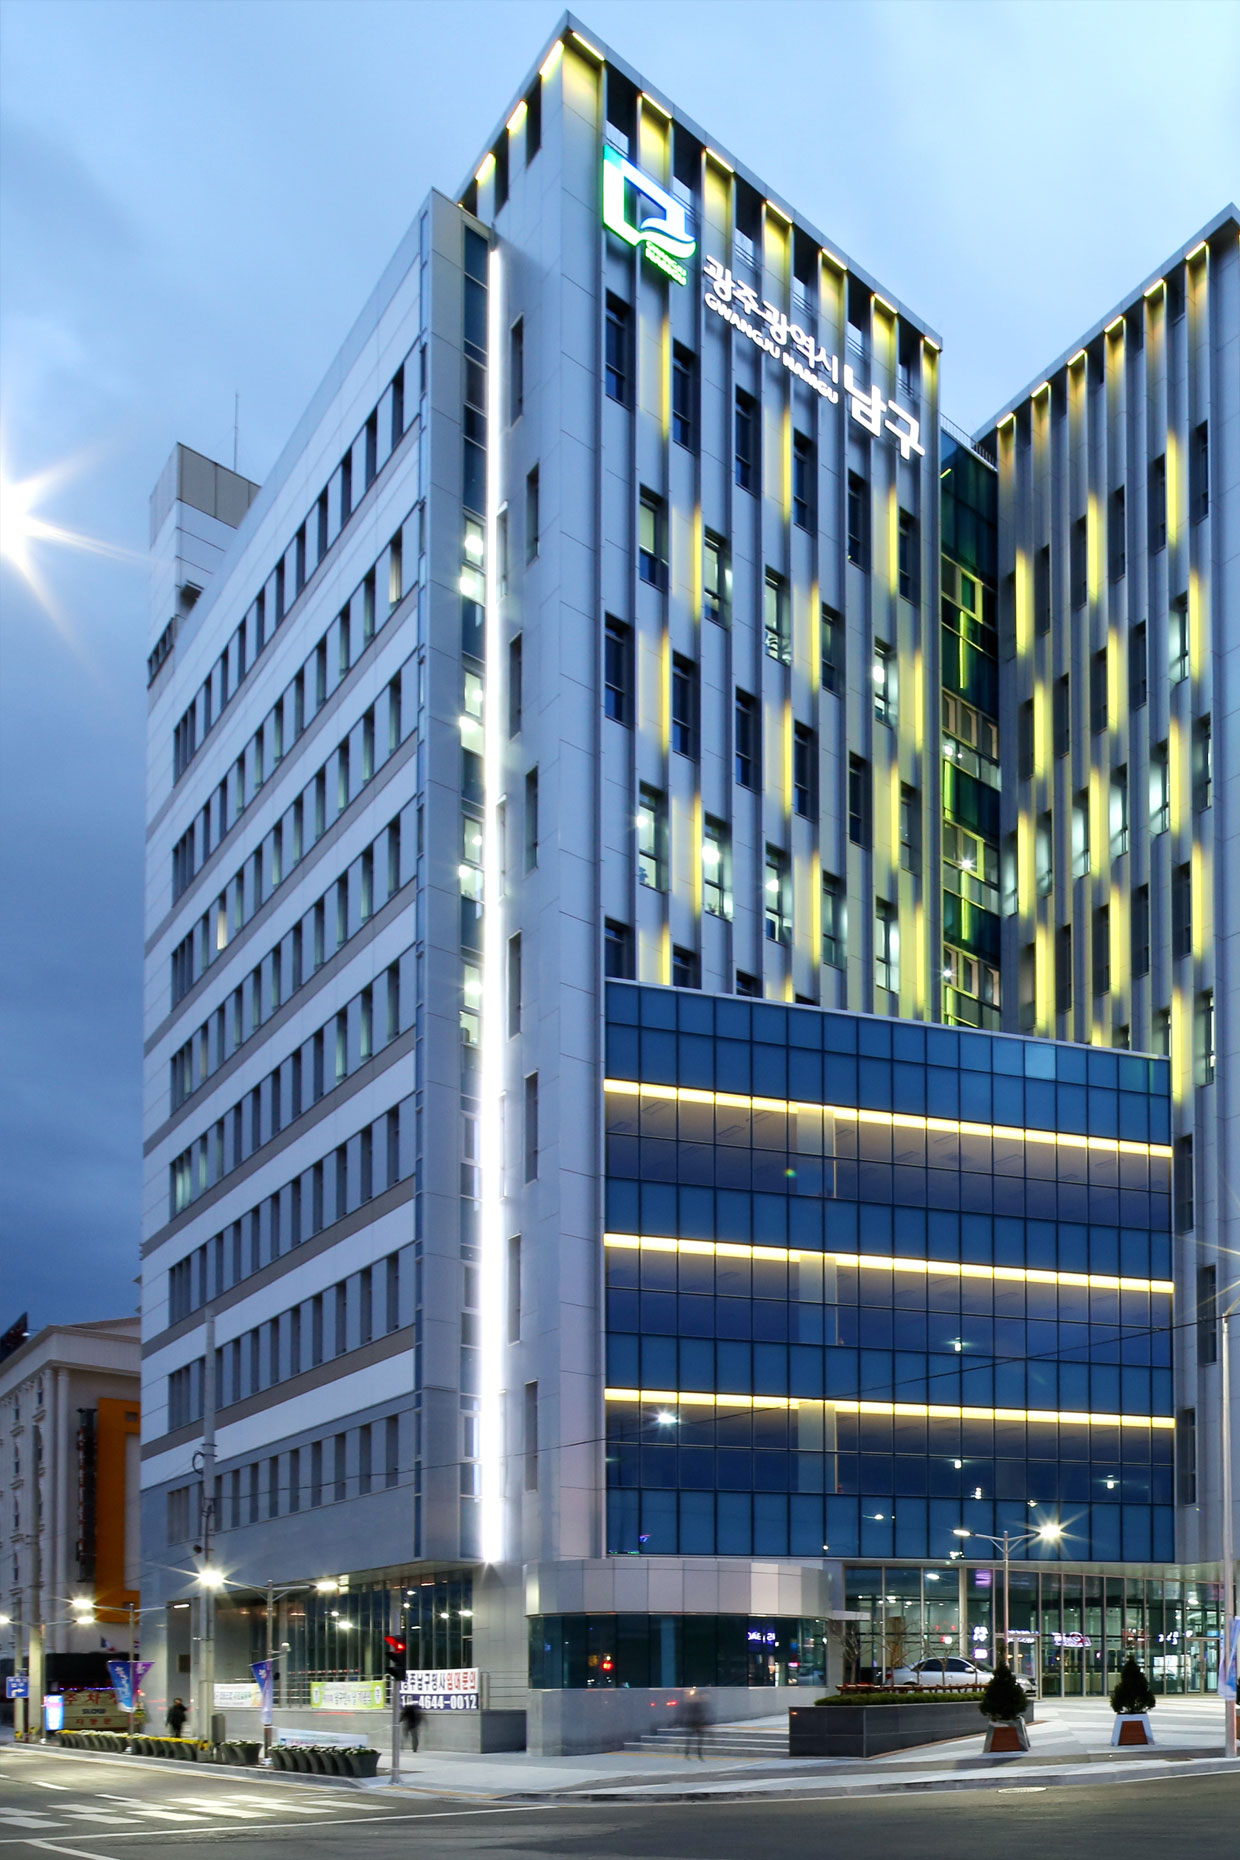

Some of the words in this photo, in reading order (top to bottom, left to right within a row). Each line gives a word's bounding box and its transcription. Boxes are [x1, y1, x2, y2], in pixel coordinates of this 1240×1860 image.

[704, 293, 780, 360] GWANGJU
[704, 255, 838, 383] 광주광역시
[844, 364, 925, 460] 남구
[446, 1671, 476, 1691] 임대문의
